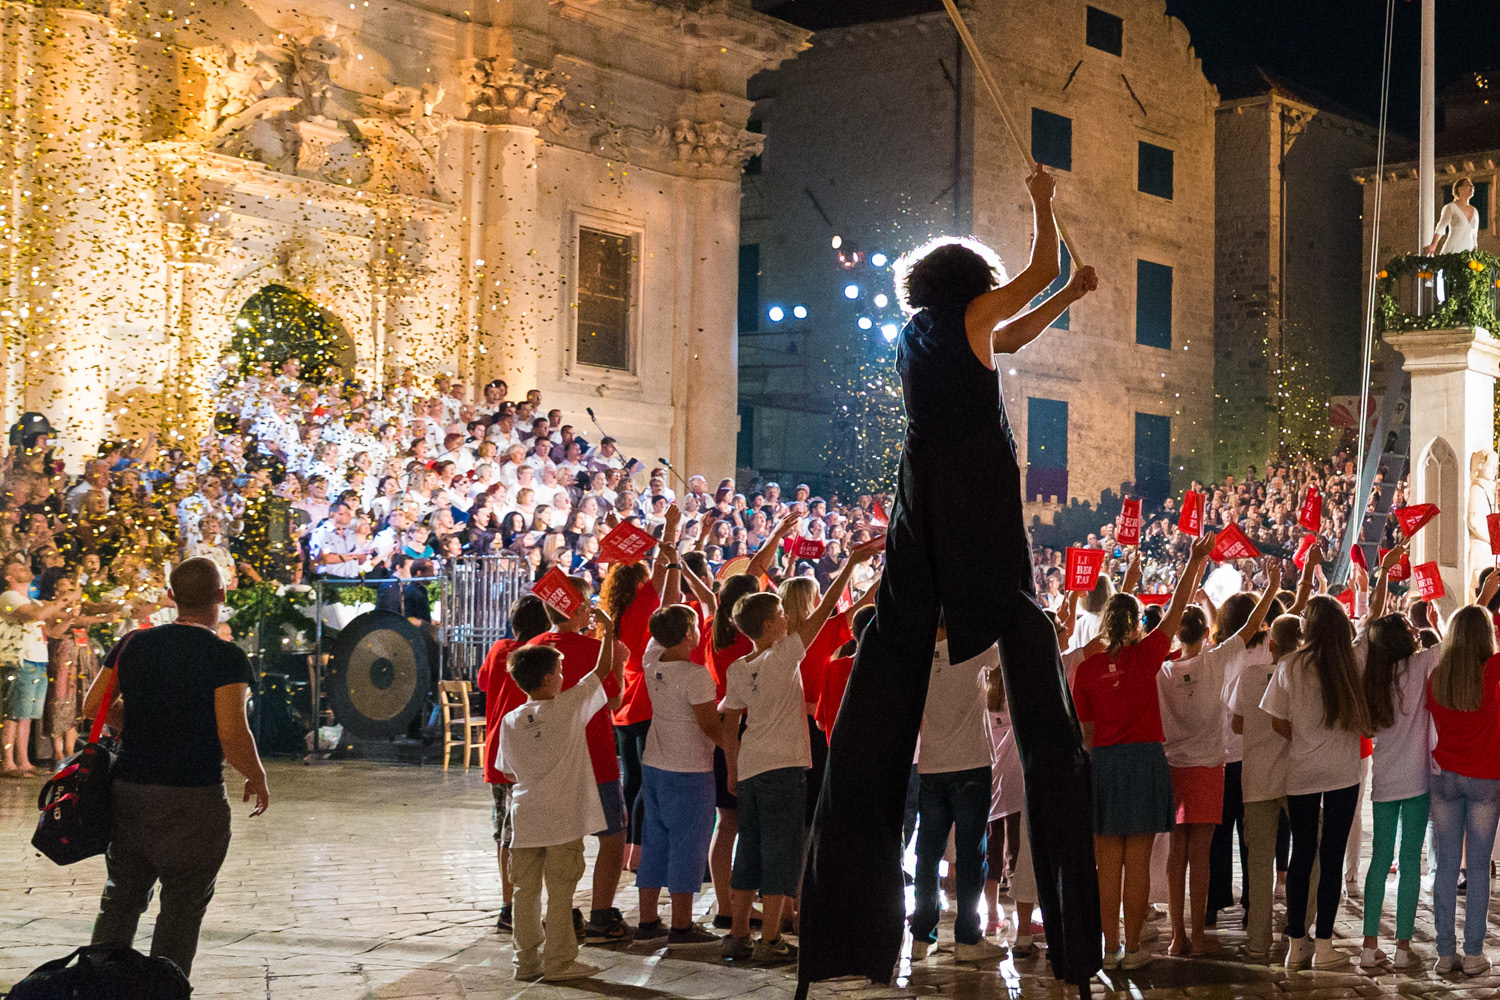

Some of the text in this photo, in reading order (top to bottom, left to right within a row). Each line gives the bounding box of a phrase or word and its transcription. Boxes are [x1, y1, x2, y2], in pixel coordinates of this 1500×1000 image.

[1077, 556, 1088, 565] LI
[1075, 565, 1093, 575] BER
[1415, 570, 1424, 580] LI
[1075, 575, 1091, 585] TAS
[1418, 577, 1435, 588] BER
[1419, 586, 1435, 597] TAS
